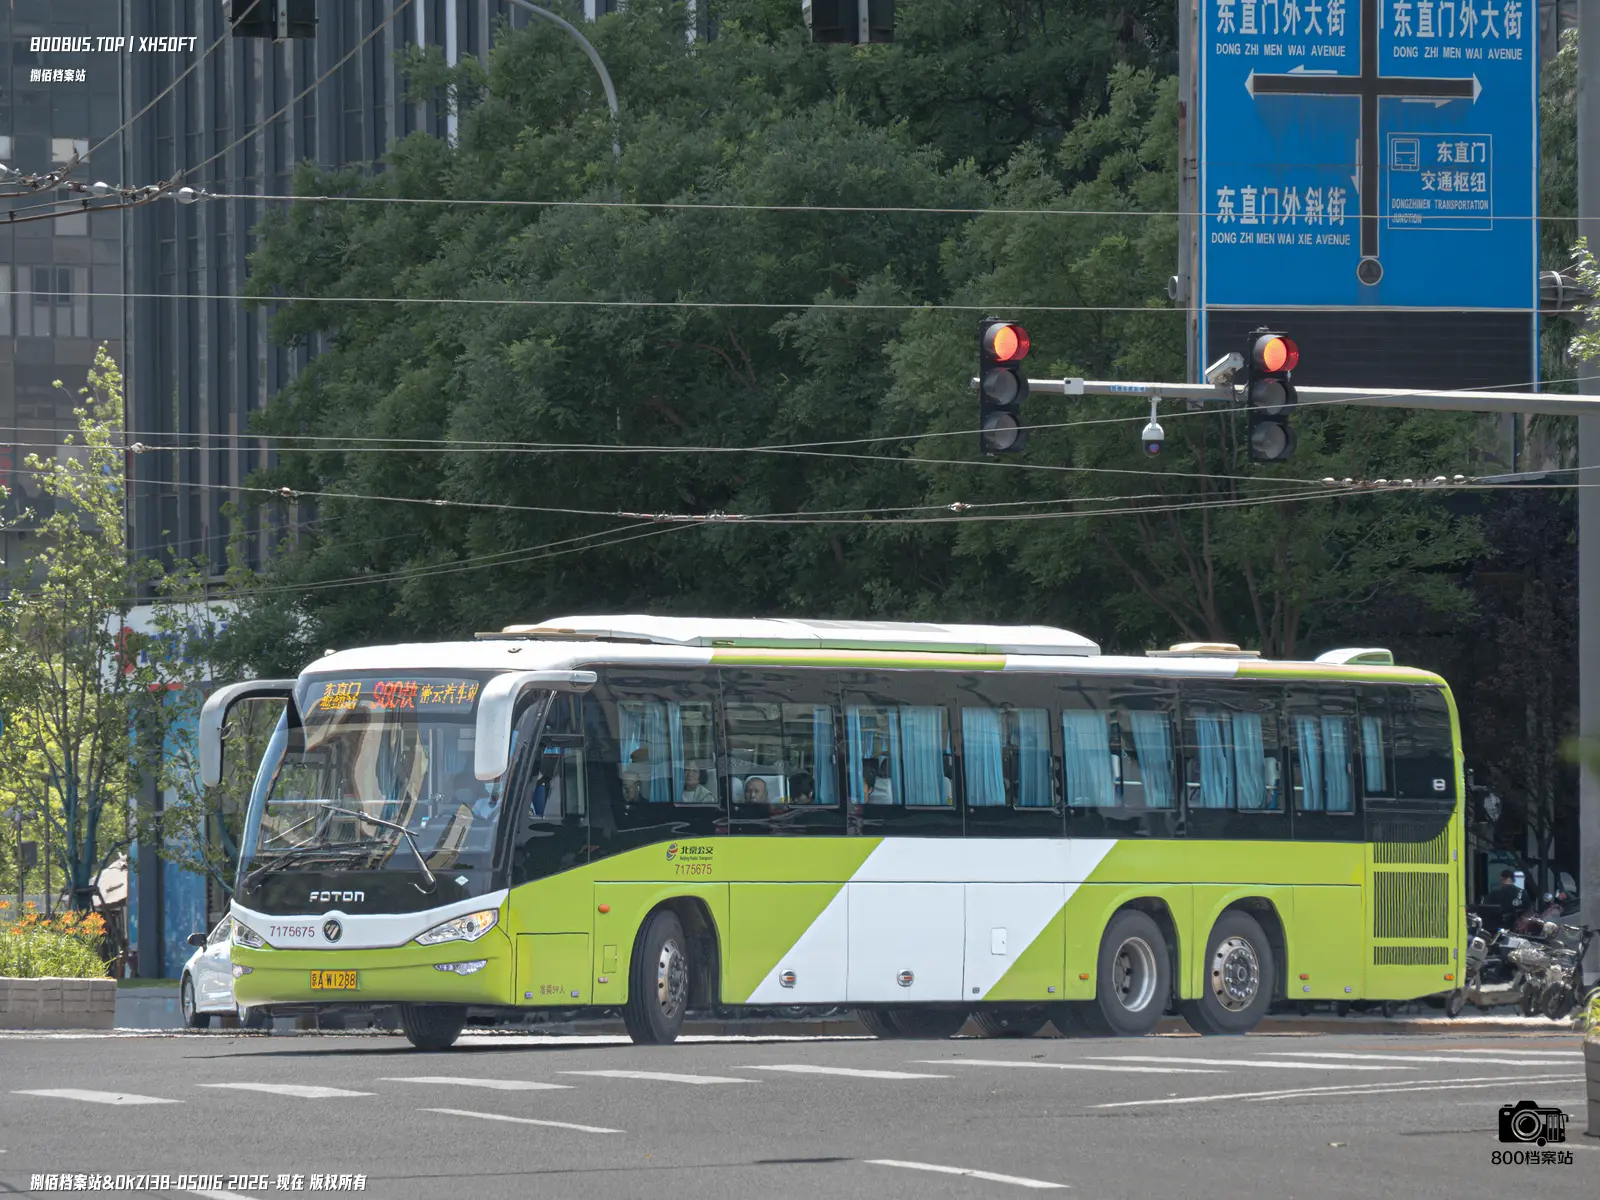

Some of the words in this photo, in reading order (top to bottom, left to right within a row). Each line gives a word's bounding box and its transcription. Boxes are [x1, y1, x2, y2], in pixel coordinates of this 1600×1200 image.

[1216, 0, 1346, 36] 东直门外大街
[1393, 0, 1523, 40] 东直门外大街
[1216, 43, 1241, 55] DONG
[1244, 43, 1259, 56] ZHI
[1263, 44, 1283, 56] MEN
[1287, 44, 1306, 56] WAI
[1310, 45, 1346, 57] AVENUE
[1393, 46, 1418, 58] DONG
[1424, 46, 1439, 58] ZHI
[1443, 46, 1462, 59] MEN
[1465, 47, 1483, 59] WAI
[1487, 48, 1523, 60] AVENUE
[1436, 141, 1486, 163] 东直门
[1421, 170, 1487, 193] 交通枢纽
[1216, 184, 1347, 226] 东直门外斜街
[1391, 198, 1431, 209] DONGZHIMEN
[1434, 199, 1489, 210] TRANSPORTATION
[1391, 212, 1422, 224] JUNCTION
[1211, 232, 1237, 244] DONG
[1239, 232, 1254, 244] ZHI
[1256, 233, 1275, 244] MEN
[1277, 233, 1295, 245] WAI
[1298, 233, 1313, 245] XIE
[1315, 234, 1351, 246] AVENUE
[680, 845, 714, 855] 北京公交
[674, 863, 713, 875] 7175675
[309, 891, 365, 902] FOTON
[270, 925, 315, 938] 7175675
